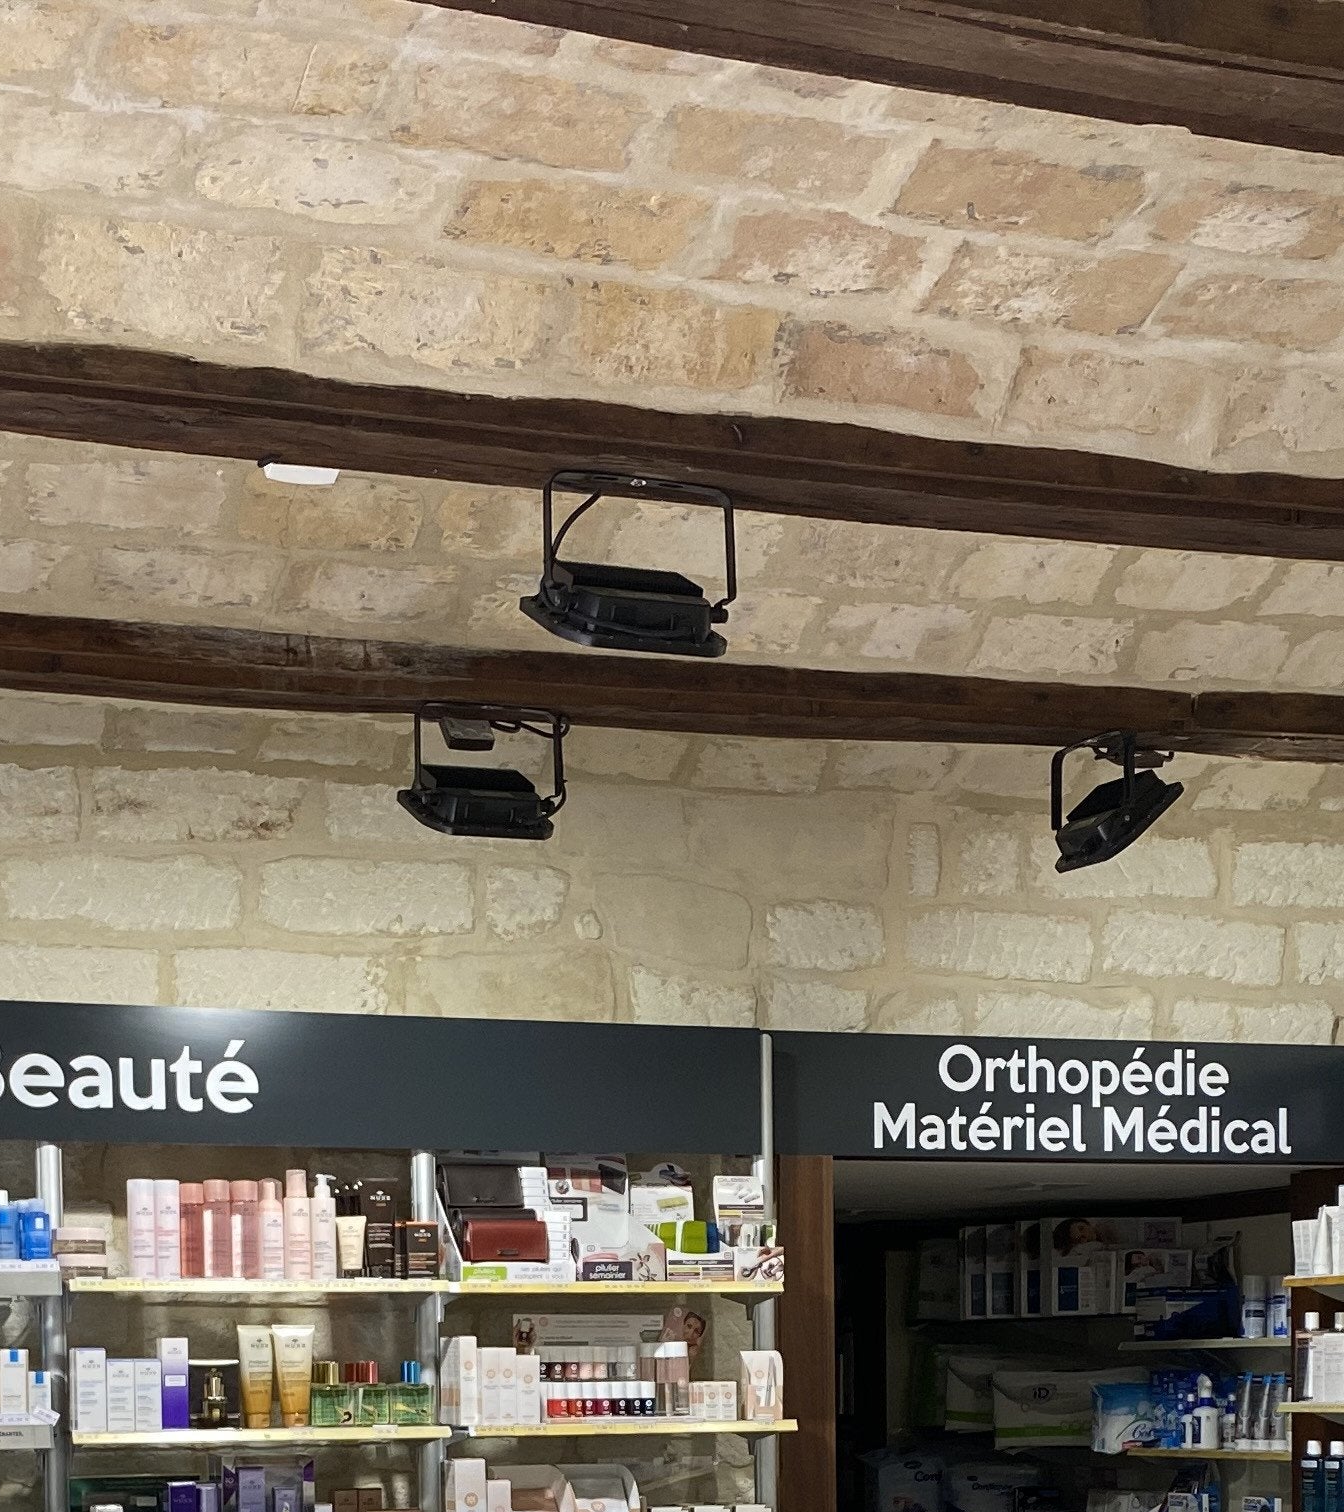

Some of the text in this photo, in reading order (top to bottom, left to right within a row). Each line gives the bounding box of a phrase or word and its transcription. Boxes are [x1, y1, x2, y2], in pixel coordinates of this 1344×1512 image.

[938, 1044, 1230, 1108] Orthopédie
[873, 1101, 1293, 1155] Matériel Médical
